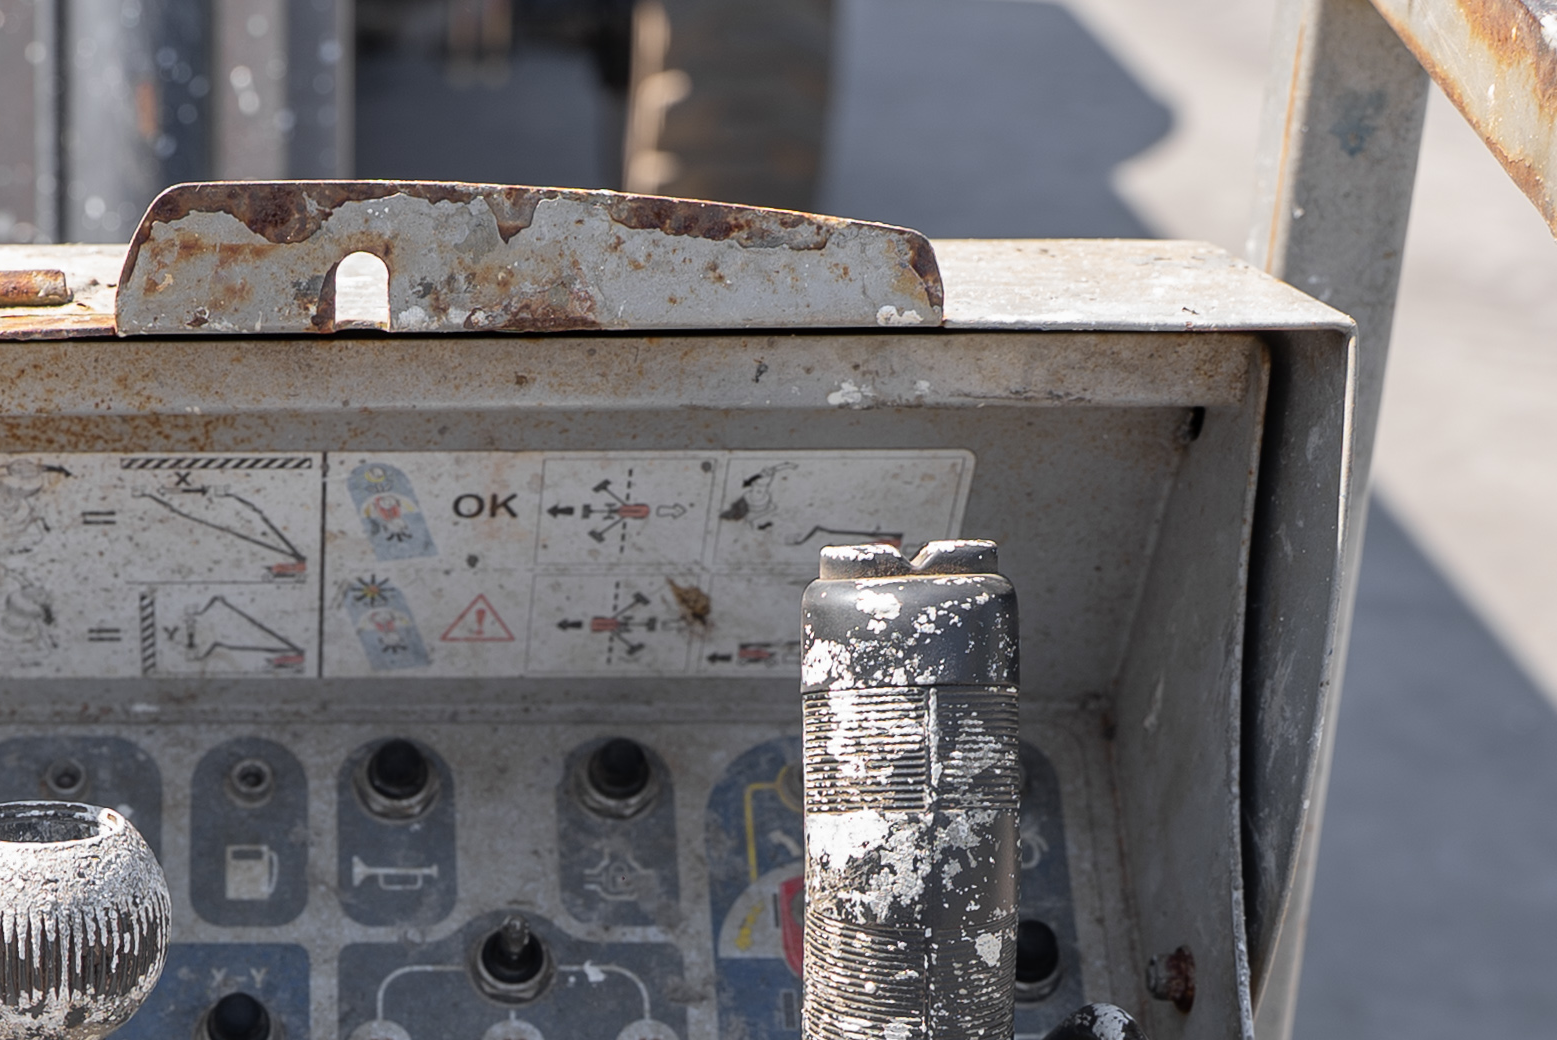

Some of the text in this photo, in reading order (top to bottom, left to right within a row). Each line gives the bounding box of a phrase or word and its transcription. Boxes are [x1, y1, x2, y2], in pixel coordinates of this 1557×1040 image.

[175, 471, 192, 486] X
[452, 492, 518, 518] OK
[163, 626, 179, 640] Y
